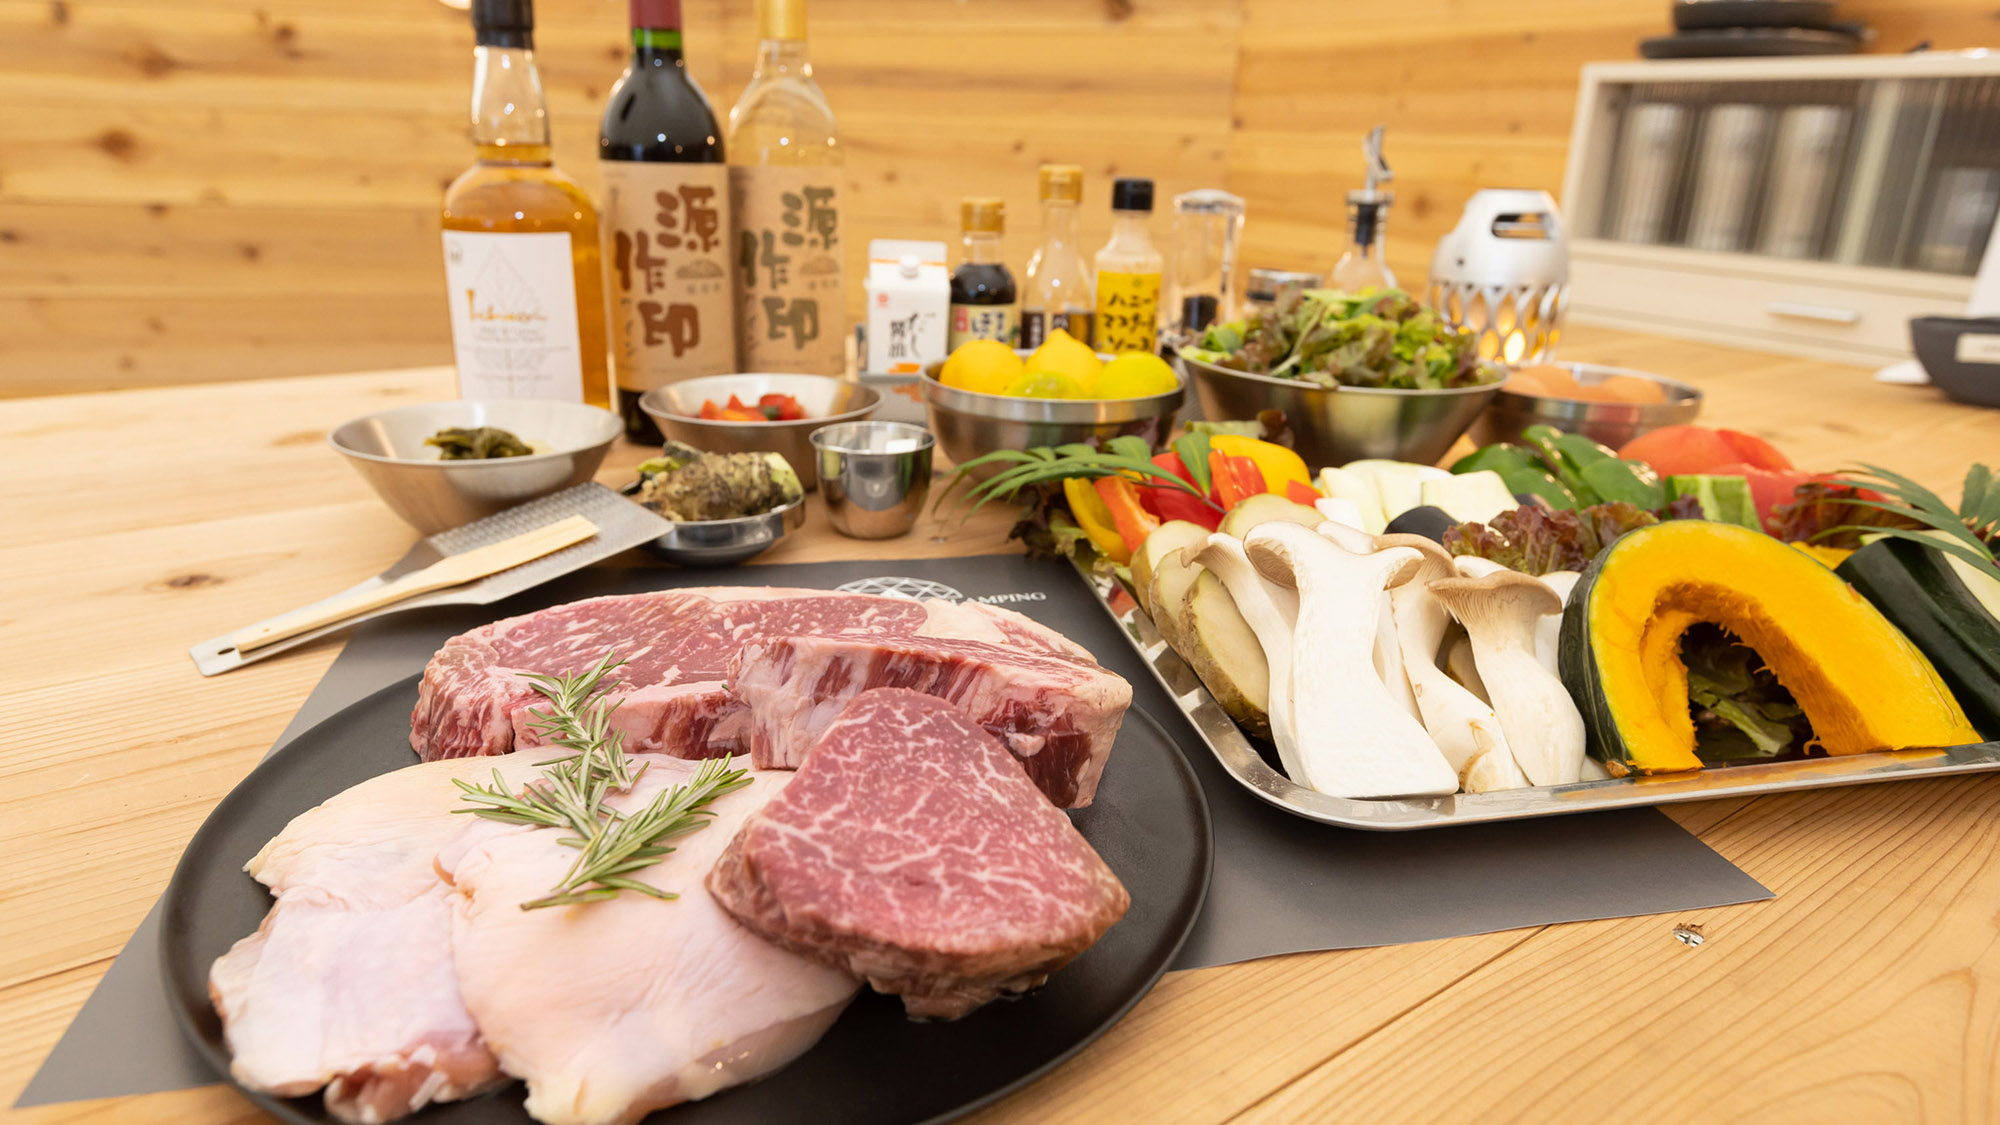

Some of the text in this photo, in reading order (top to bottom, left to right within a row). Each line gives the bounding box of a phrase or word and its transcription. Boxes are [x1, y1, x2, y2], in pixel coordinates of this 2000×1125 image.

[1107, 293, 1152, 308] ハニー
[1107, 335, 1151, 351] ソース
